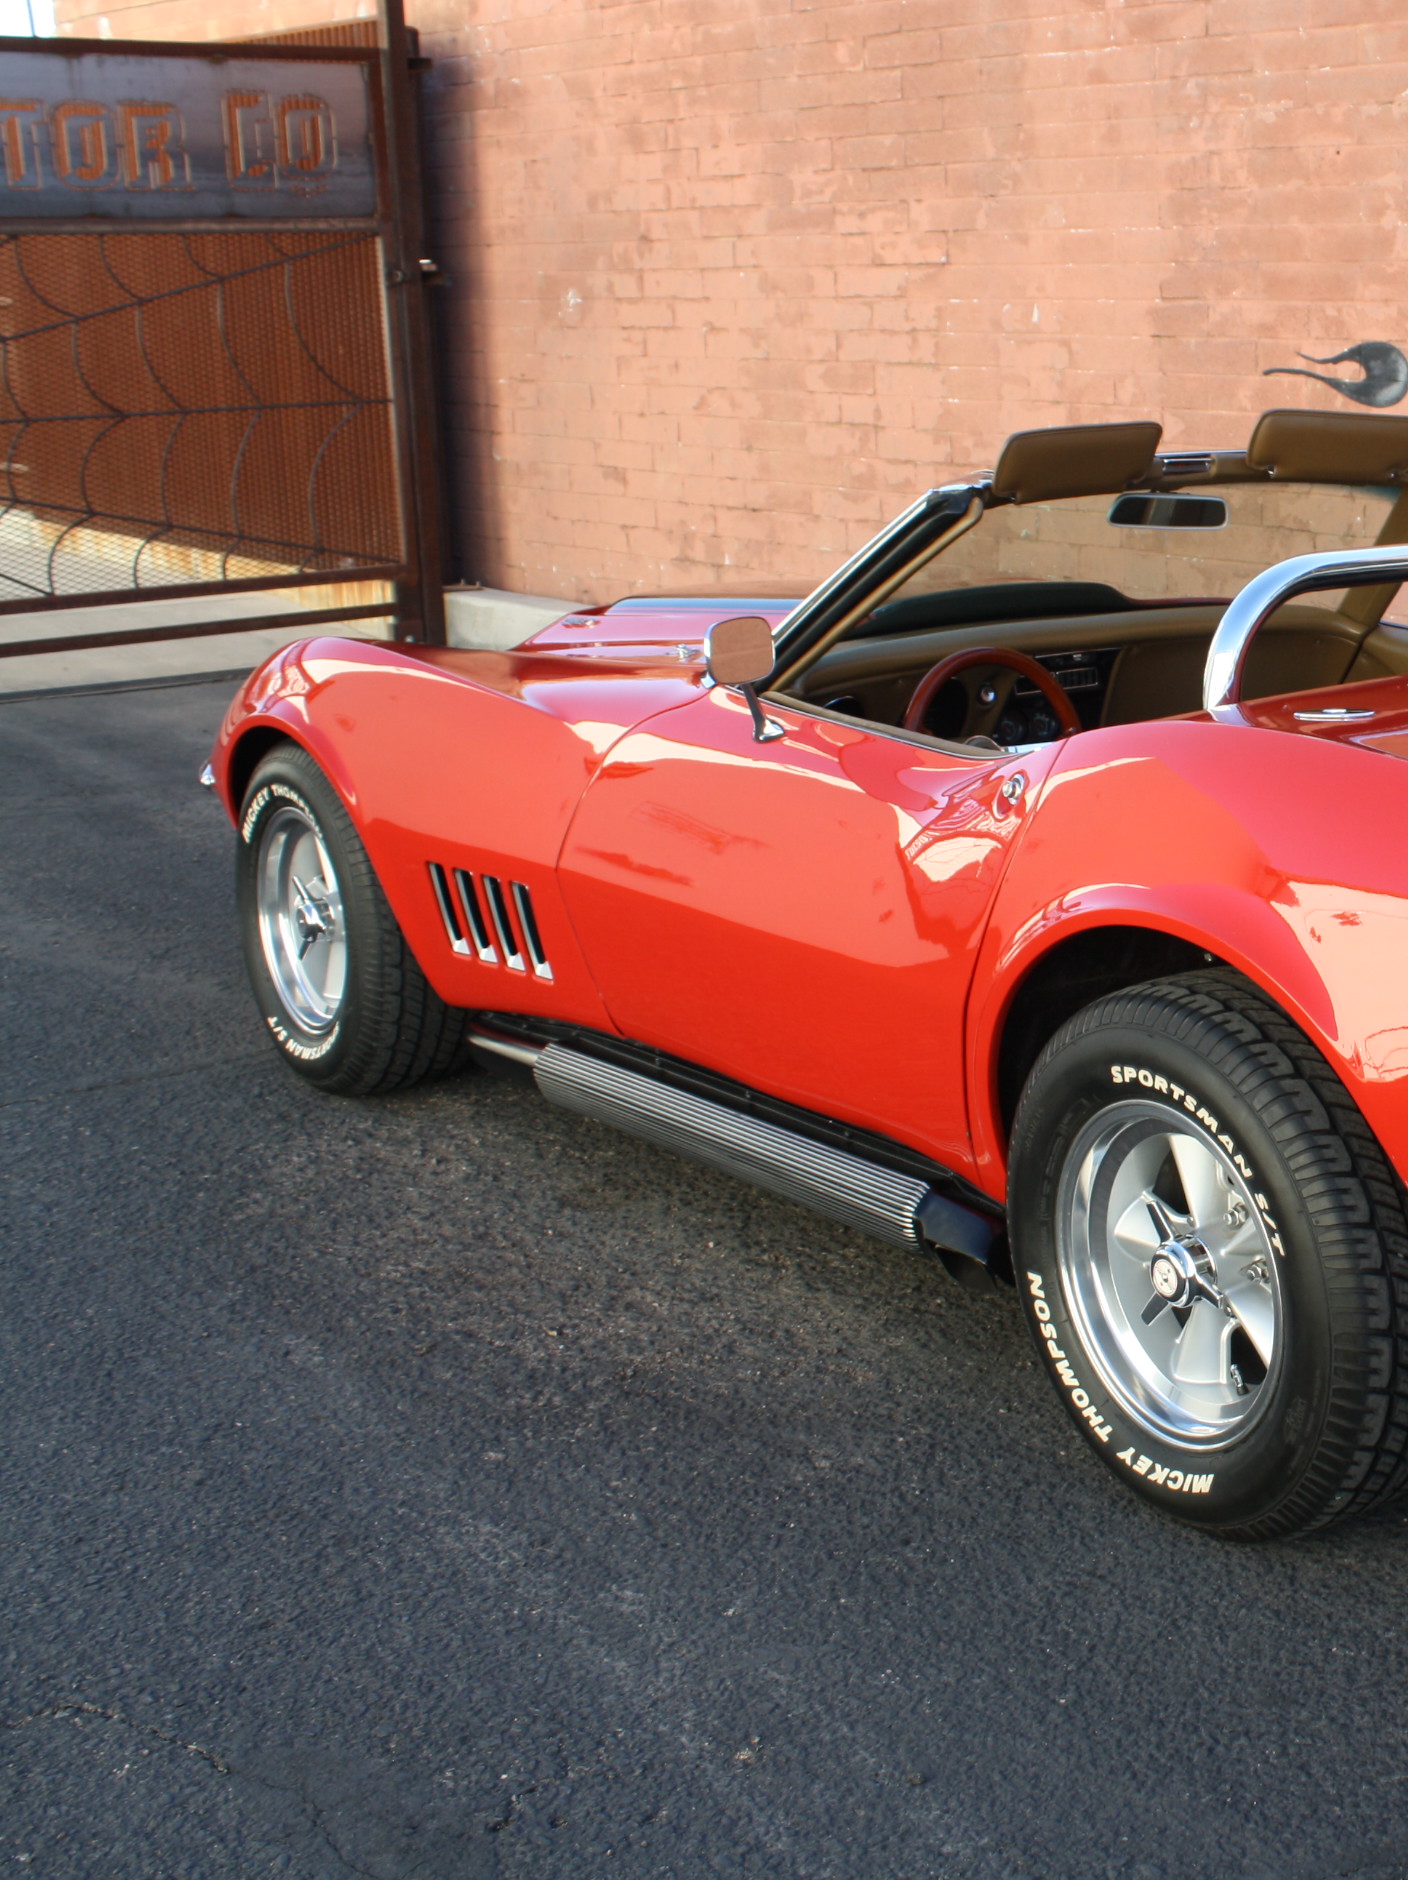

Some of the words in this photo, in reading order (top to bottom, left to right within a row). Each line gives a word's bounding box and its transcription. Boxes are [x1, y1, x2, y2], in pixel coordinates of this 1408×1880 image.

[221, 88, 338, 195] CO
[242, 786, 269, 844] MICKEY
[266, 1016, 288, 1041] S/T
[285, 1020, 340, 1060] SPORTSMAN
[1110, 1065, 1253, 1179] SPORTSMAN
[1254, 1193, 1285, 1257] S/T
[1027, 1271, 1113, 1443] THOMPSON
[1116, 1446, 1215, 1493] MICKEY
